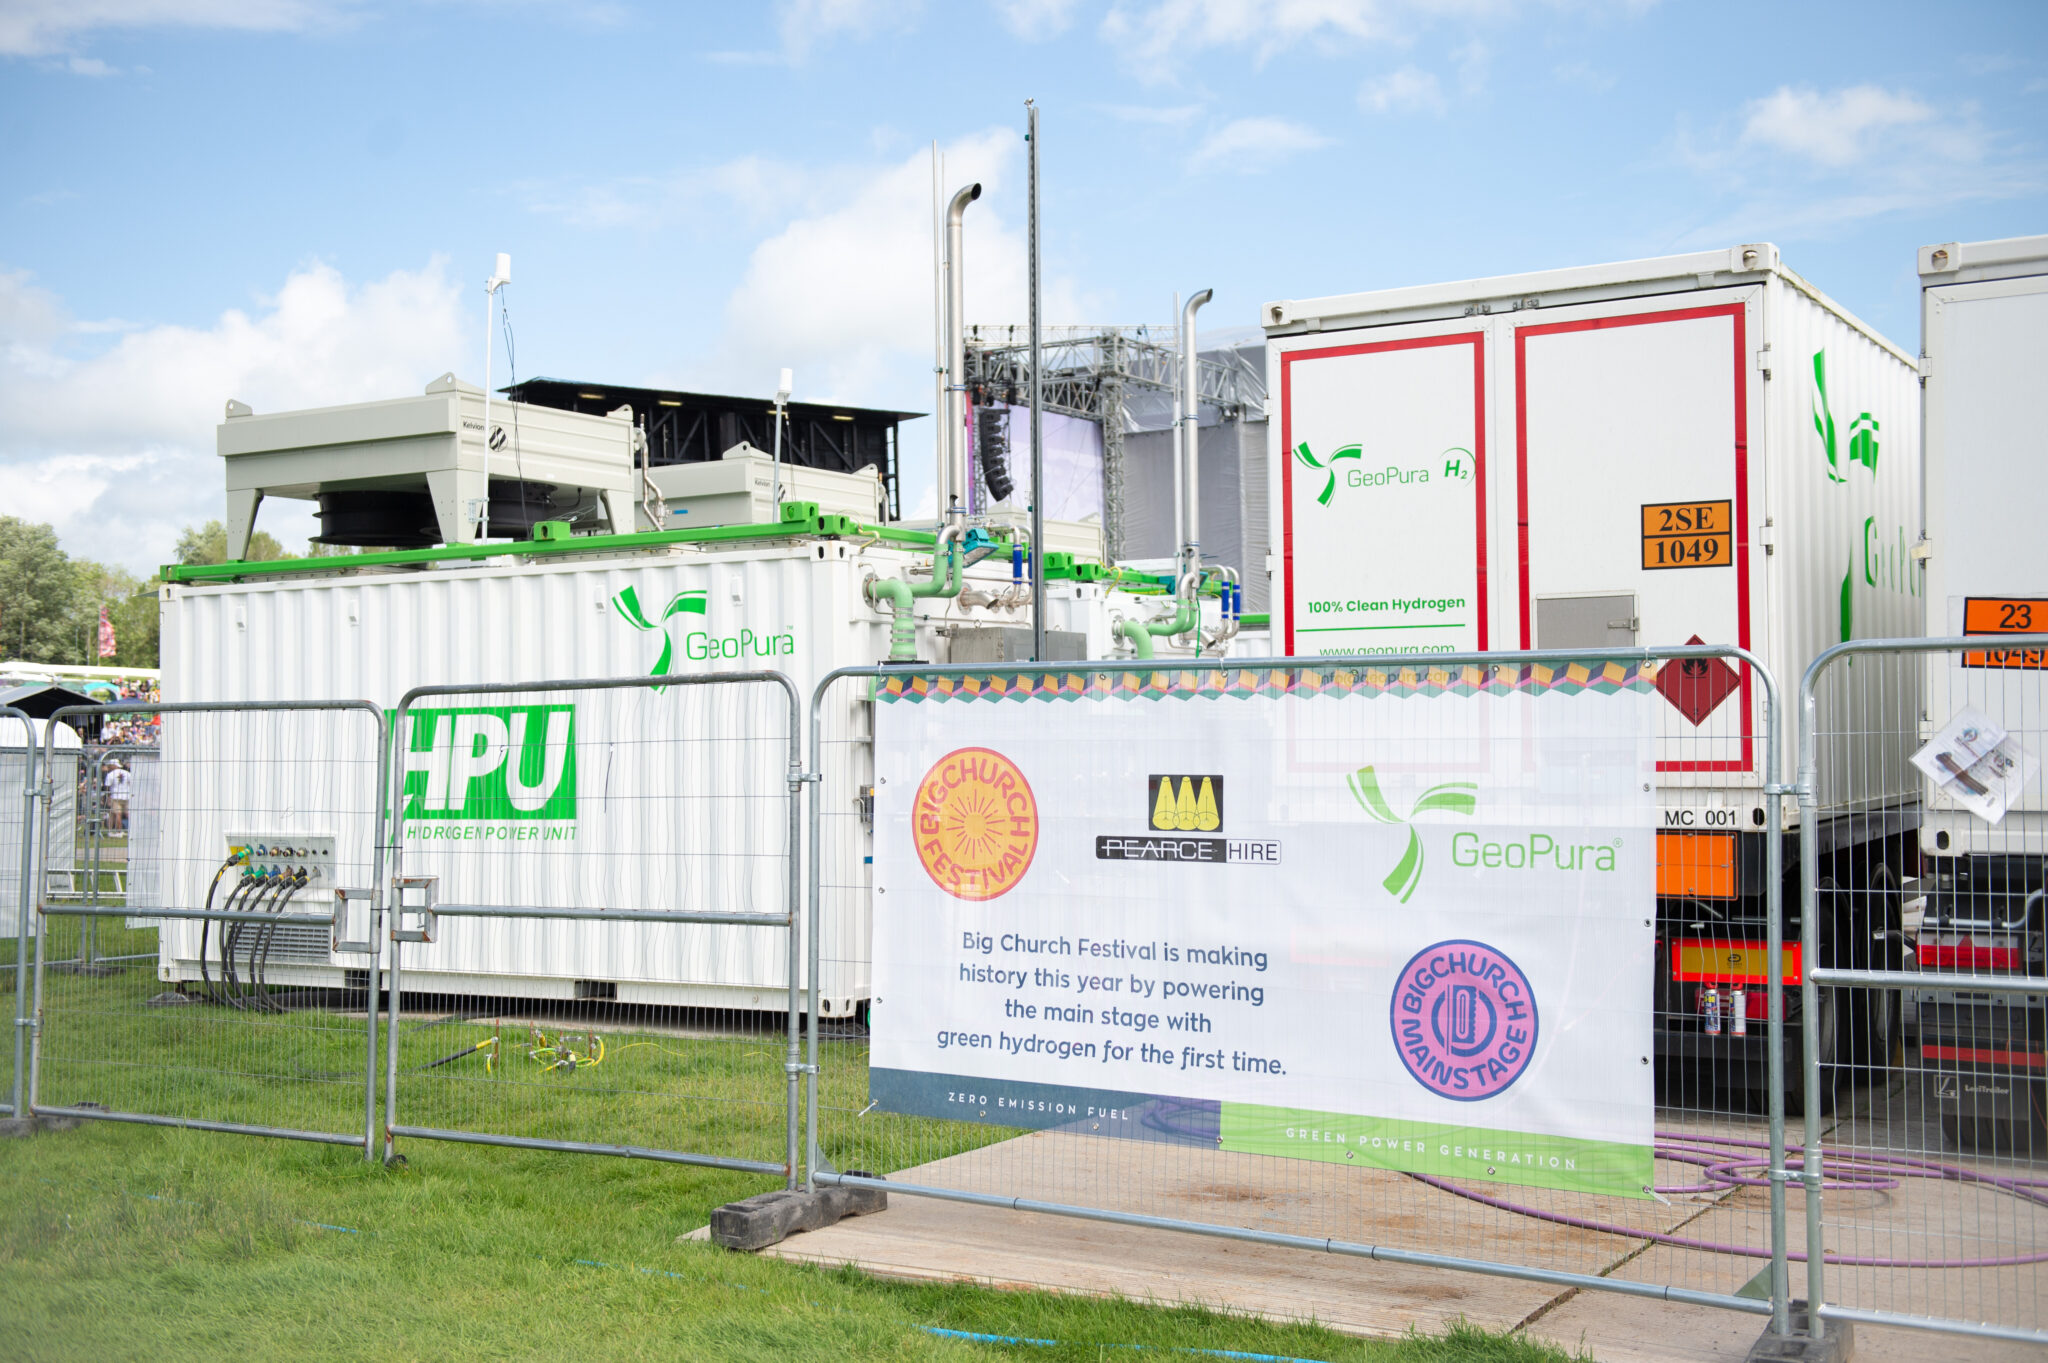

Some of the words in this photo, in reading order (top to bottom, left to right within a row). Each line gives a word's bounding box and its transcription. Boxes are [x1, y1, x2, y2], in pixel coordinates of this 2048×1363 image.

[463, 420, 485, 431] Kelvion
[1347, 467, 1429, 488] GeoPura
[1659, 507, 1714, 531] 2SE
[1655, 538, 1719, 563] 1049
[1308, 601, 1343, 613] 100%
[1347, 599, 1388, 612] Clean
[1392, 597, 1465, 613] Hydrogen
[1999, 604, 2032, 629] 23
[387, 711, 571, 811] HPU
[1665, 810, 1694, 826] MC
[1705, 810, 1735, 826] 001
[407, 826, 482, 840] HYDROGEN
[485, 826, 539, 840] POWER
[544, 826, 577, 840] UNIT
[1102, 839, 1213, 860] PEARCE
[1229, 843, 1277, 861] HIRE
[923, 839, 1029, 890] FESTIVAL
[963, 932, 993, 954] Big
[1000, 934, 1071, 955] Church
[1078, 938, 1156, 961] Festival
[1164, 943, 1179, 962] is
[1187, 946, 1268, 971] making
[960, 963, 1027, 989] history
[1035, 968, 1070, 988] this
[1077, 974, 1123, 993] year
[1131, 974, 1155, 998] by
[1163, 980, 1264, 1006] powering
[1005, 999, 1036, 1018] the
[1044, 1004, 1093, 1023] main
[1101, 1007, 1159, 1031] stage
[1167, 1012, 1211, 1033] with
[937, 1028, 992, 1049] green
[1000, 1032, 1096, 1059] hydrogen
[1102, 1040, 1133, 1063] for
[1141, 1043, 1174, 1065] the
[1181, 1047, 1224, 1069] first
[1233, 1051, 1287, 1076] time.
[948, 1092, 987, 1105] ZERO
[998, 1098, 1075, 1115] EMISSION
[1088, 1107, 1128, 1120] FUEL
[1286, 1128, 1345, 1143] GREEN
[1360, 1136, 1425, 1152] POWER
[1440, 1145, 1576, 1169] GENERATION
